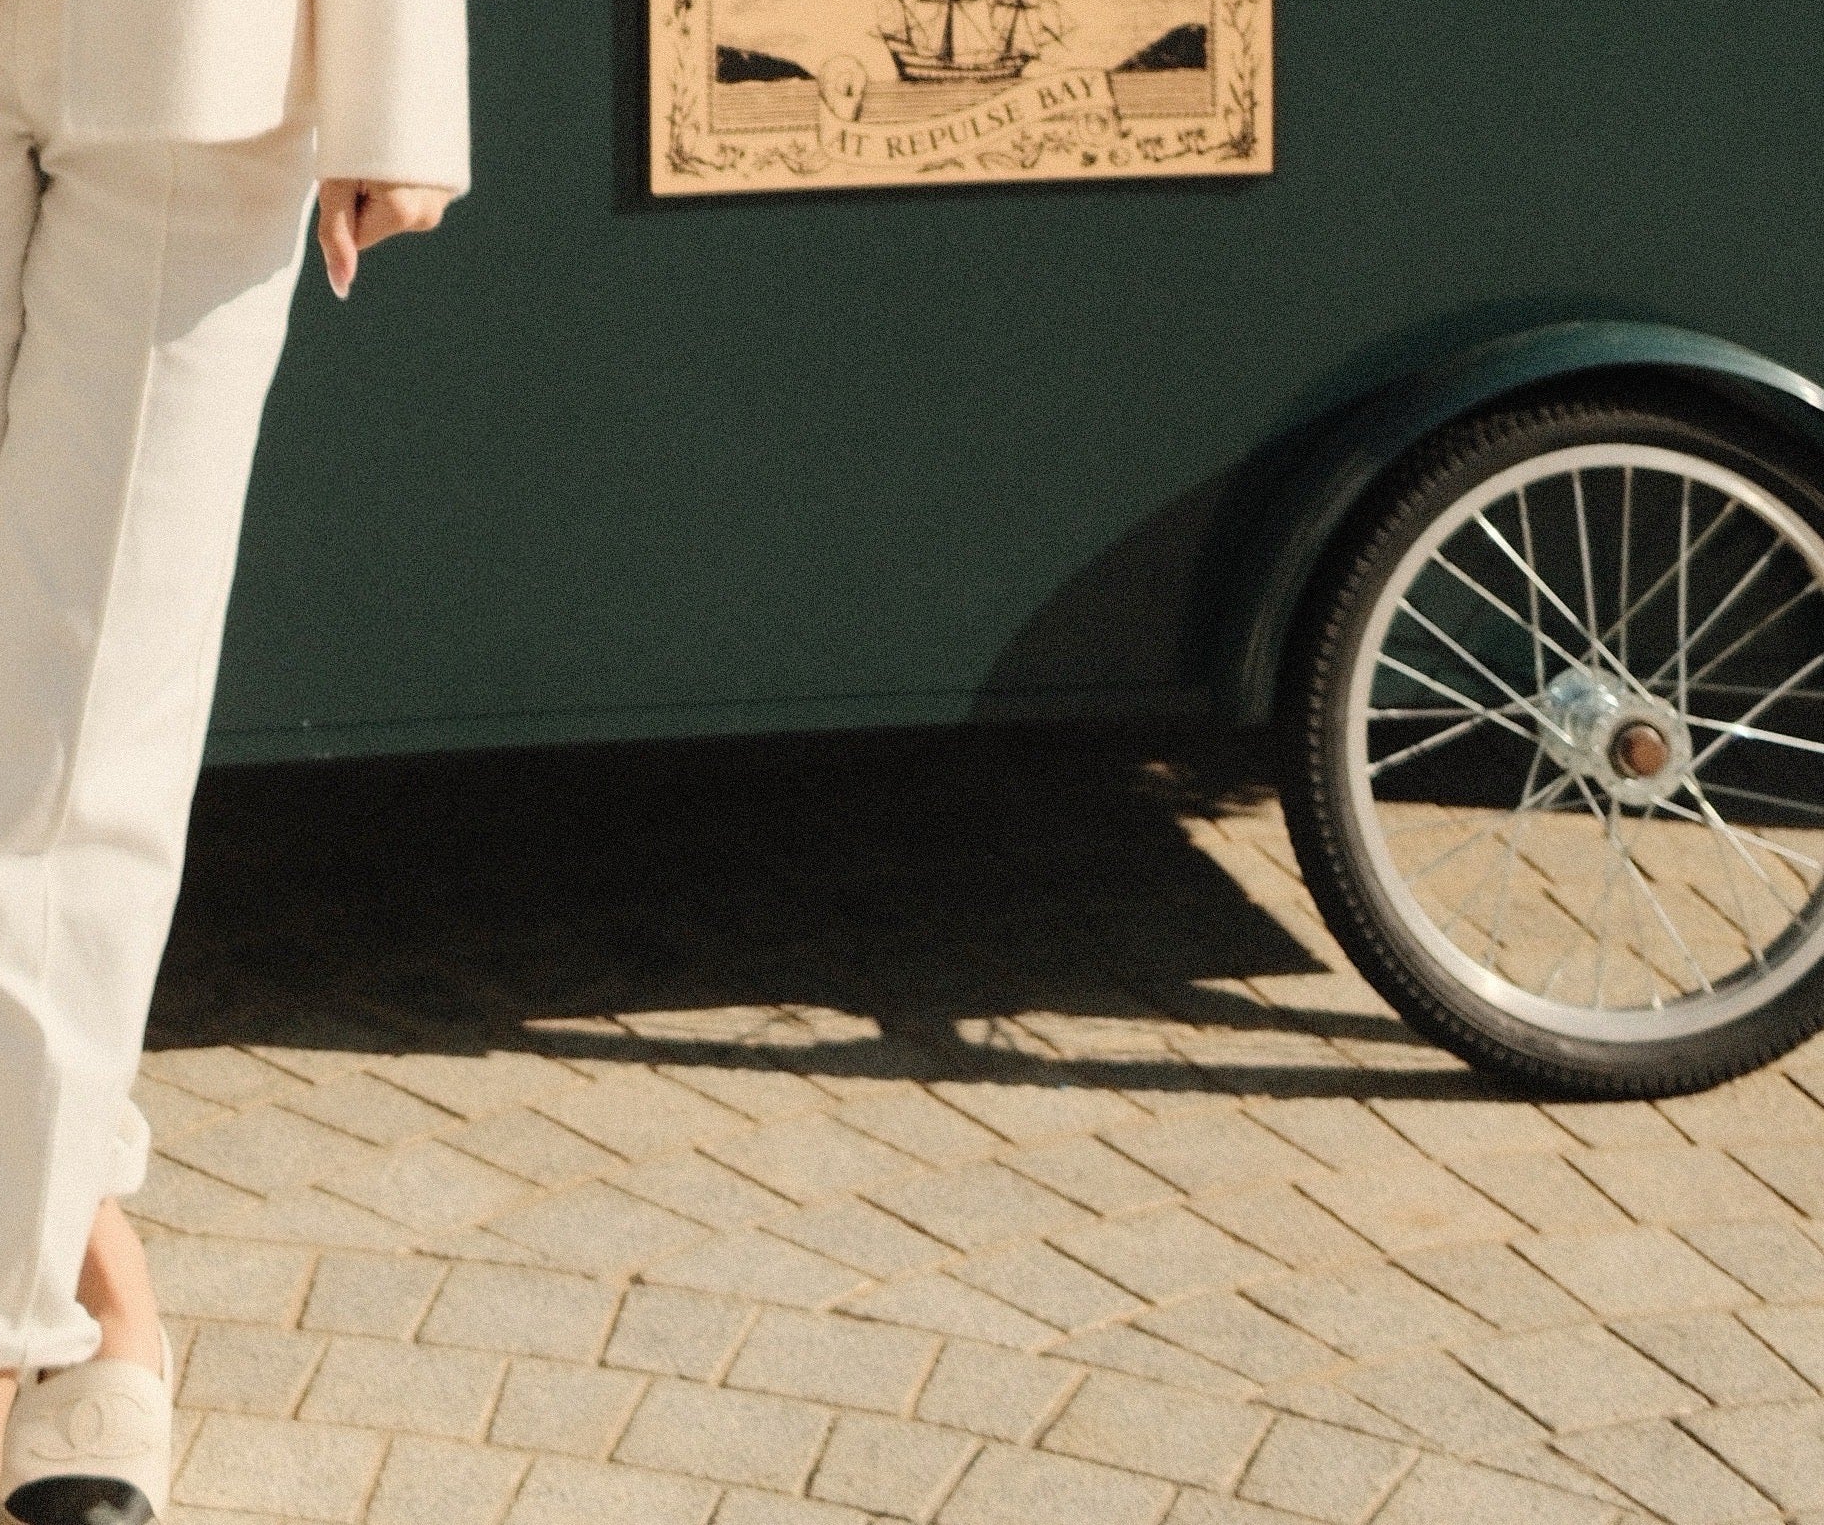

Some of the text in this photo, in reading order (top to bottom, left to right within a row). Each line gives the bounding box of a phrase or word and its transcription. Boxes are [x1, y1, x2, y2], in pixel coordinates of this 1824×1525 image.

[830, 74, 1098, 159] AT REPULSE BAY
